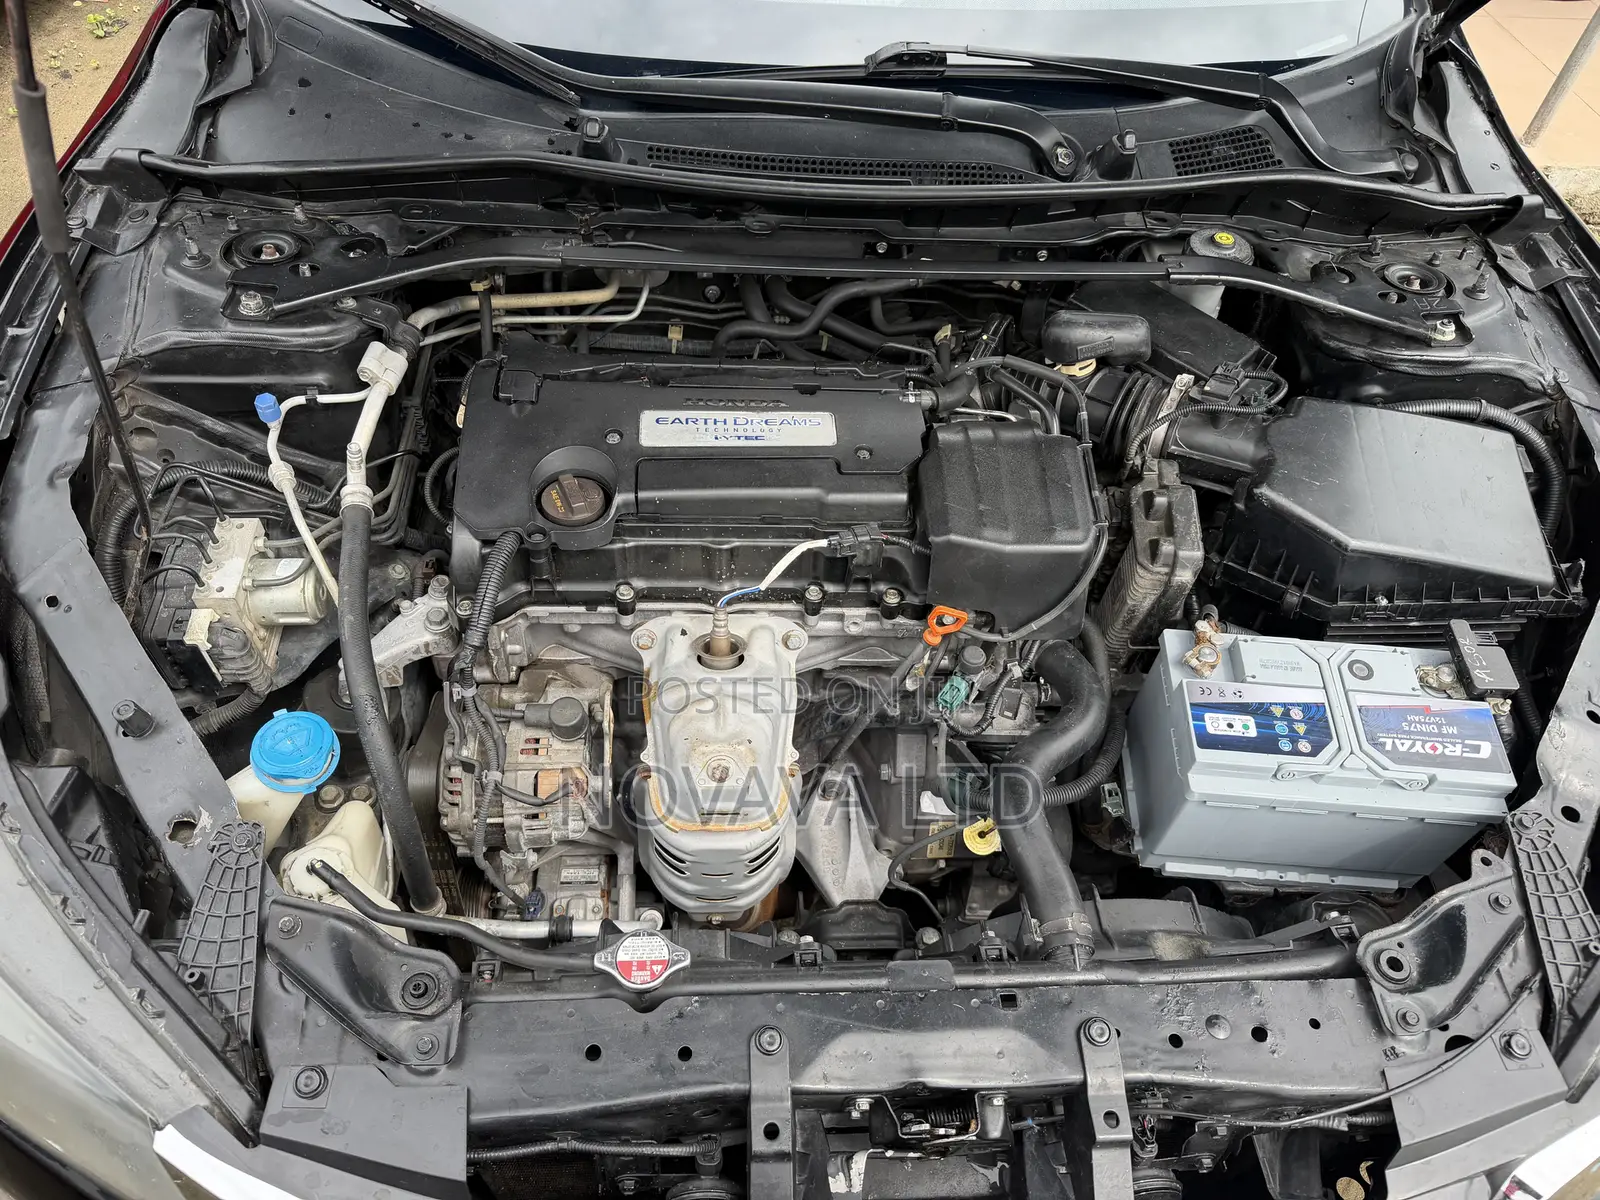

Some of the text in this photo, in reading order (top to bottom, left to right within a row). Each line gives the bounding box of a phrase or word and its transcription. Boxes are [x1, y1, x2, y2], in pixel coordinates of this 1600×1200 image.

[682, 397, 790, 408] HONDA
[655, 416, 822, 426] EARTH DREAMS
[1406, 714, 1447, 724] 12V75AH
[1402, 722, 1458, 735] MF DIN75
